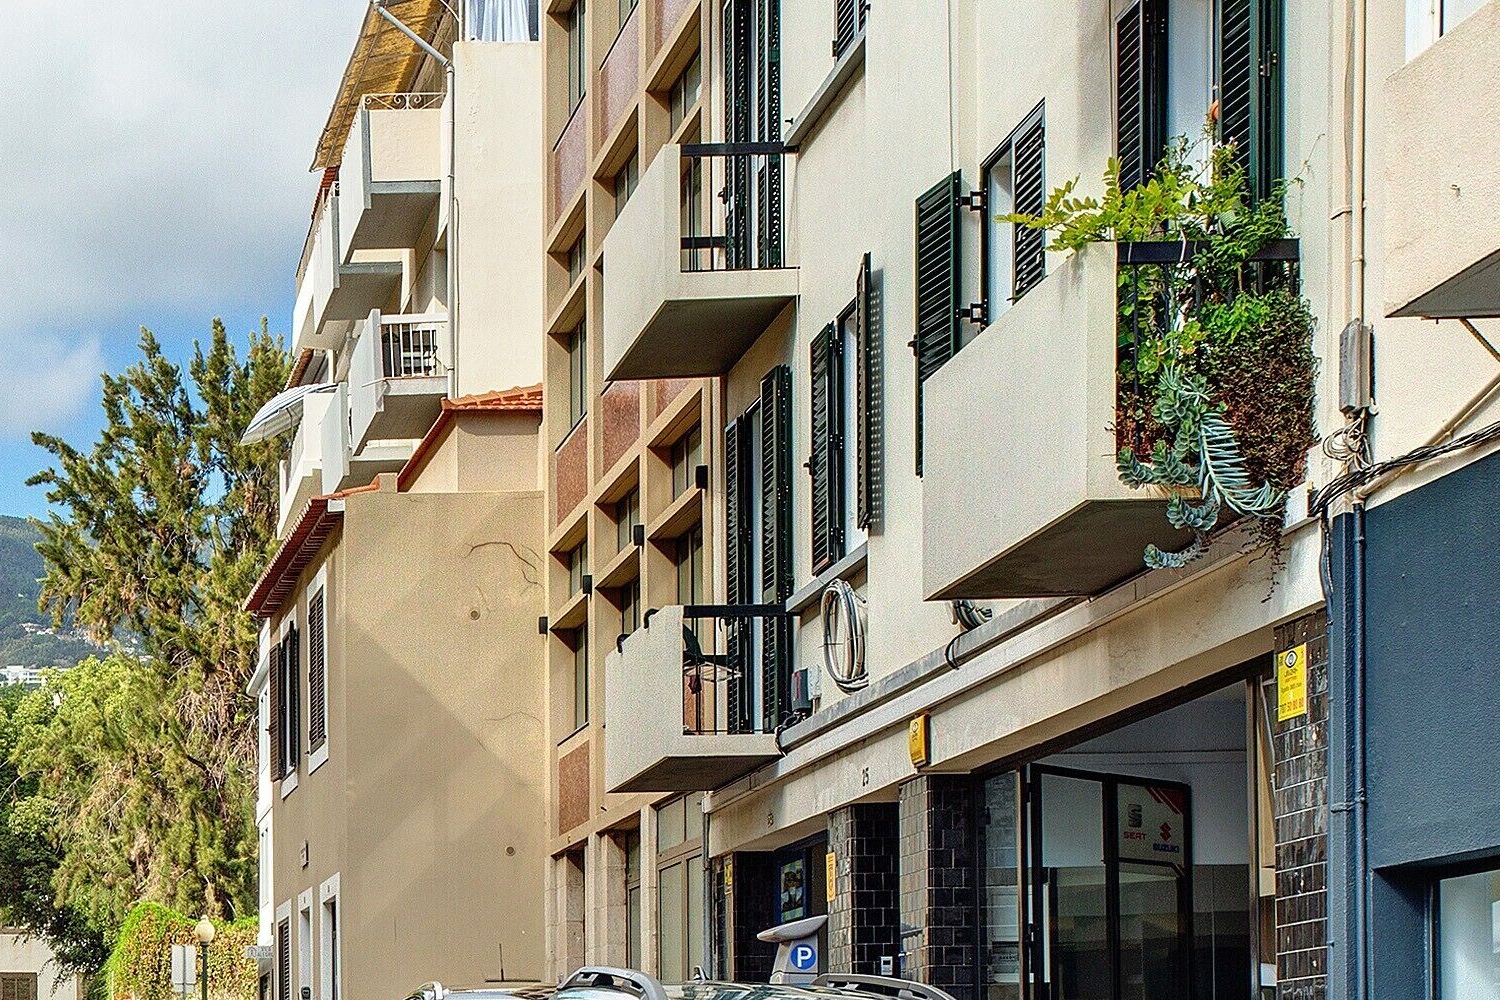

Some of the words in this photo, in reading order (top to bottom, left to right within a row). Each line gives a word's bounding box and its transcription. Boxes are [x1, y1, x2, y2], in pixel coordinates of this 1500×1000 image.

[862, 767, 870, 787] 25
[1123, 831, 1146, 840] SEAT
[1152, 843, 1180, 853] SUZUKI
[797, 947, 812, 967] P
